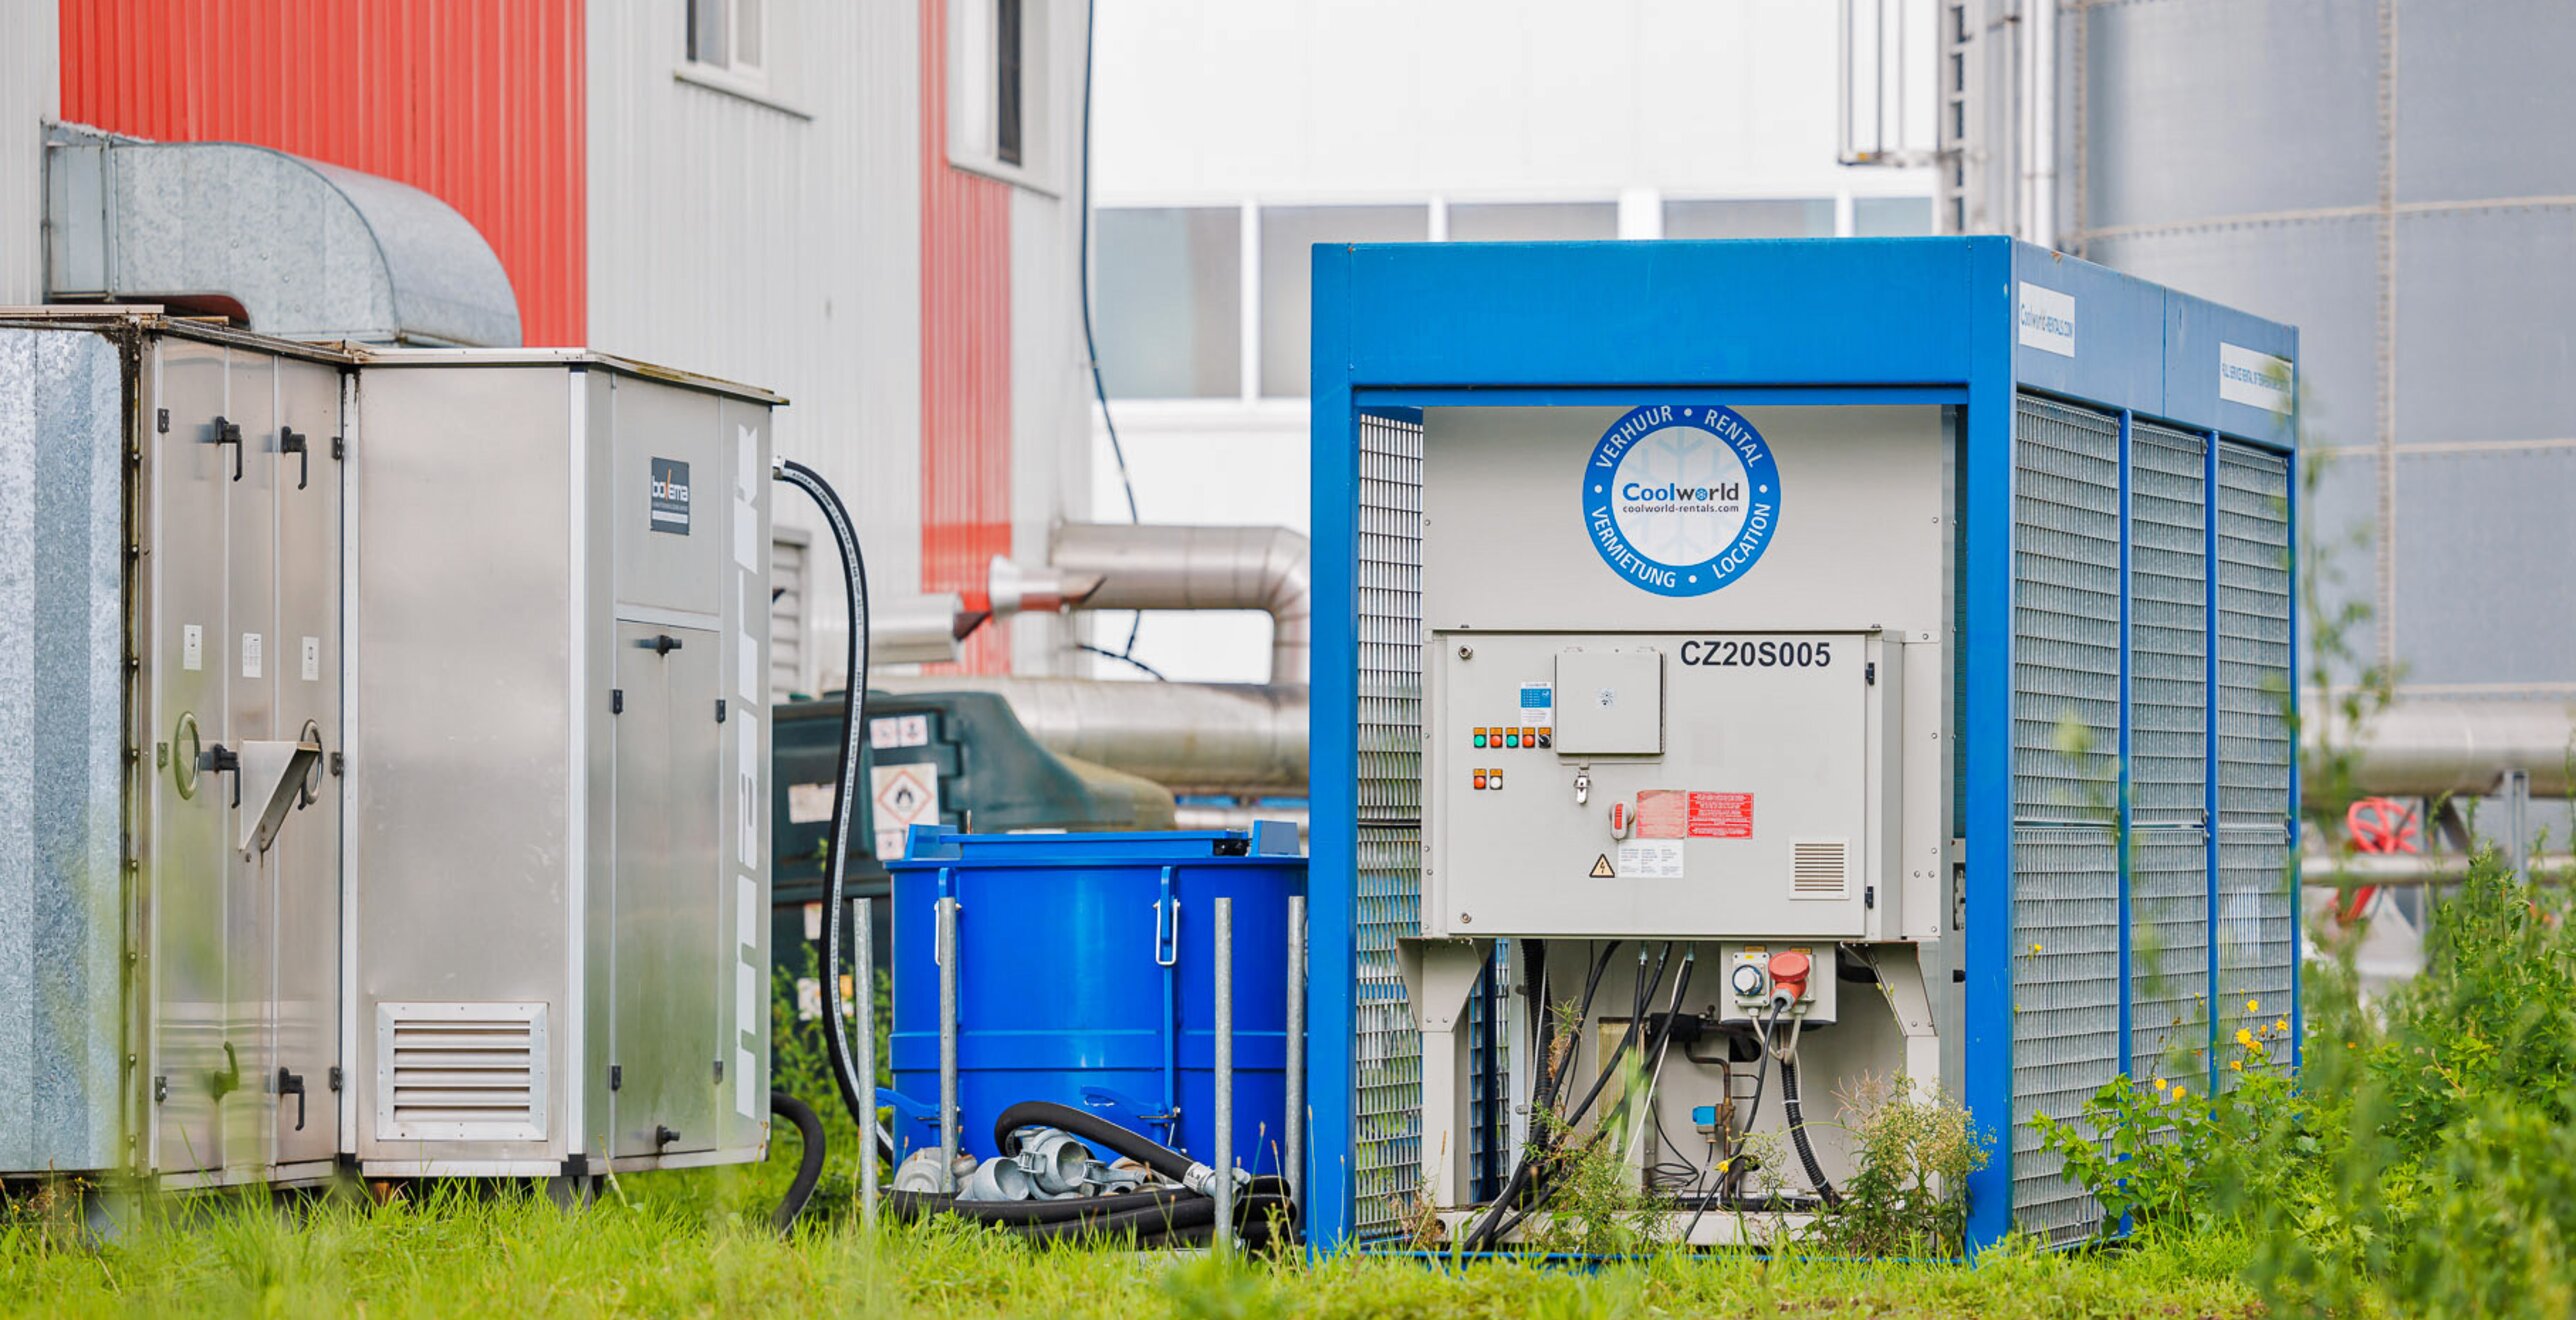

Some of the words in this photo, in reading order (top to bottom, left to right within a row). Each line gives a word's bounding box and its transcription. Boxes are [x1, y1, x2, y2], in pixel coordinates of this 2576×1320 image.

[1595, 405, 1673, 468] VERHUUR
[1704, 409, 1763, 468] RENTAL
[1622, 482, 1739, 501] Coolworld
[1622, 504, 1739, 514] coolworld-rentals.com
[1592, 506, 1676, 588] VERMIETUNG
[1712, 503, 1771, 579] LOCATION
[1680, 640, 1831, 667] CZ20S005
